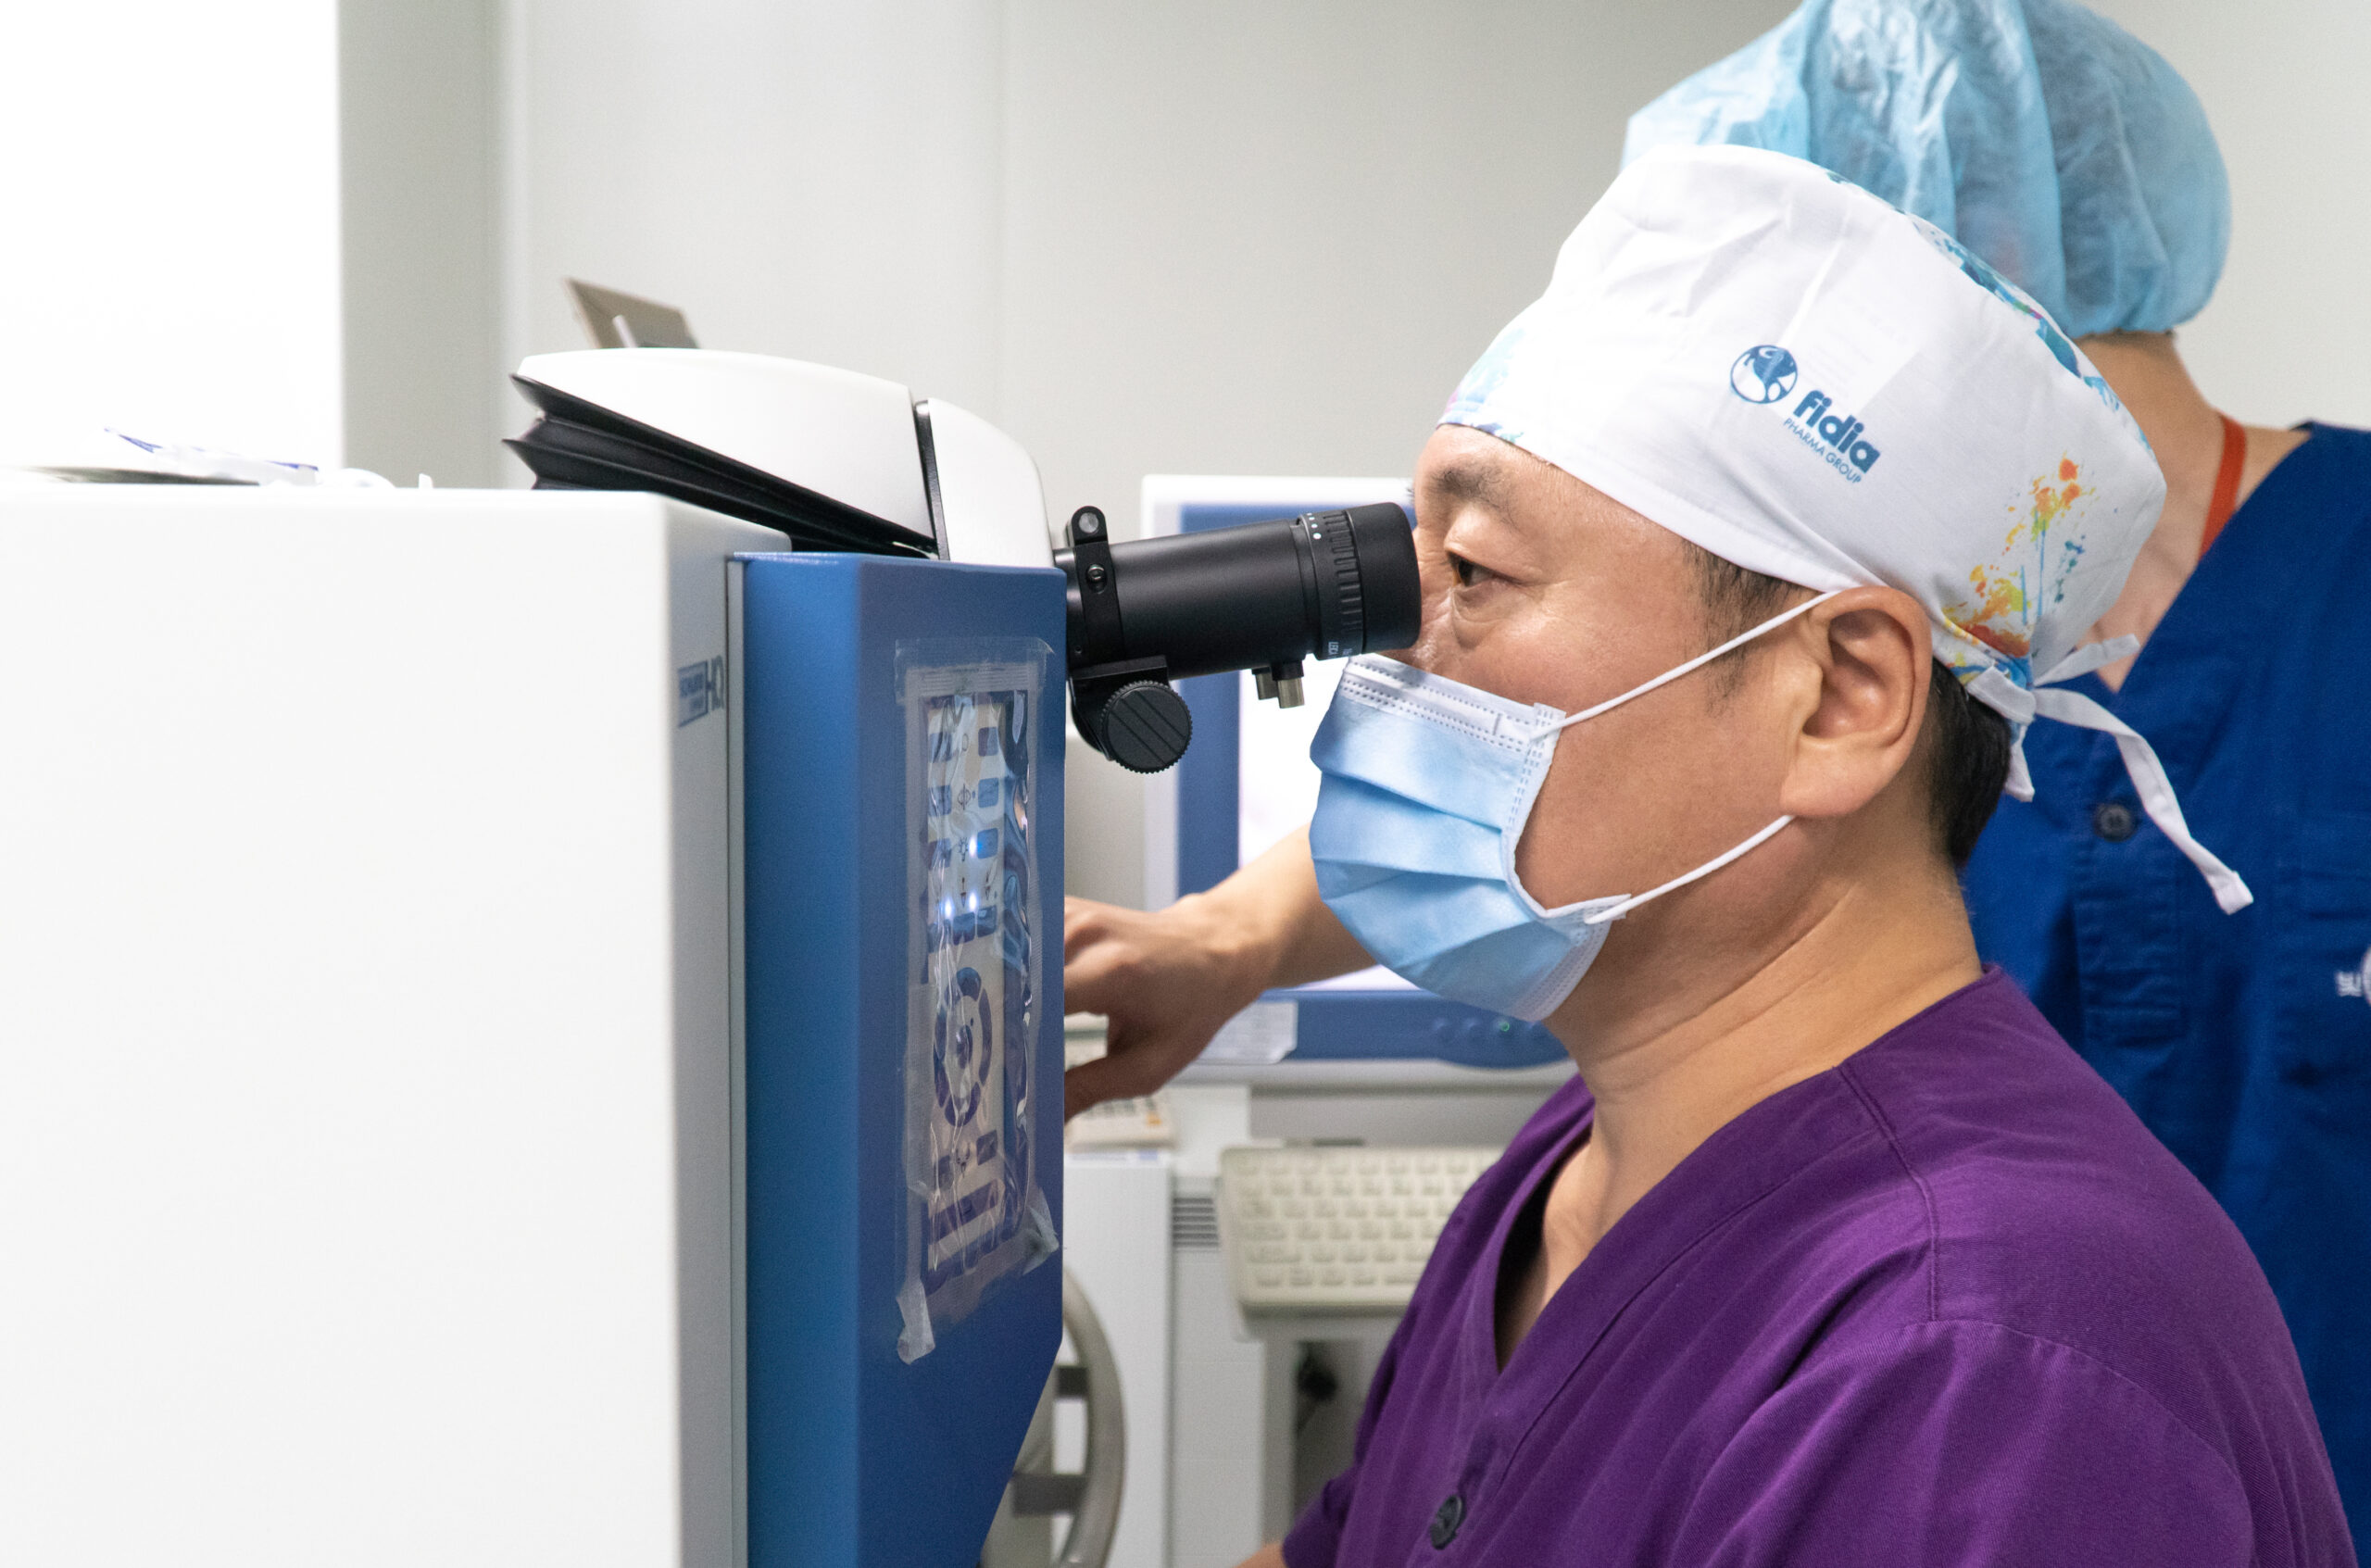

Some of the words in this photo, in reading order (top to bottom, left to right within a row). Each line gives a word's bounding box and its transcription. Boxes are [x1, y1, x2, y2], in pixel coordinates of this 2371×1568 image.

[1784, 418, 1825, 457] PHARMA
[1825, 453, 1862, 483] GROUP
[1793, 390, 1880, 474] fidia
